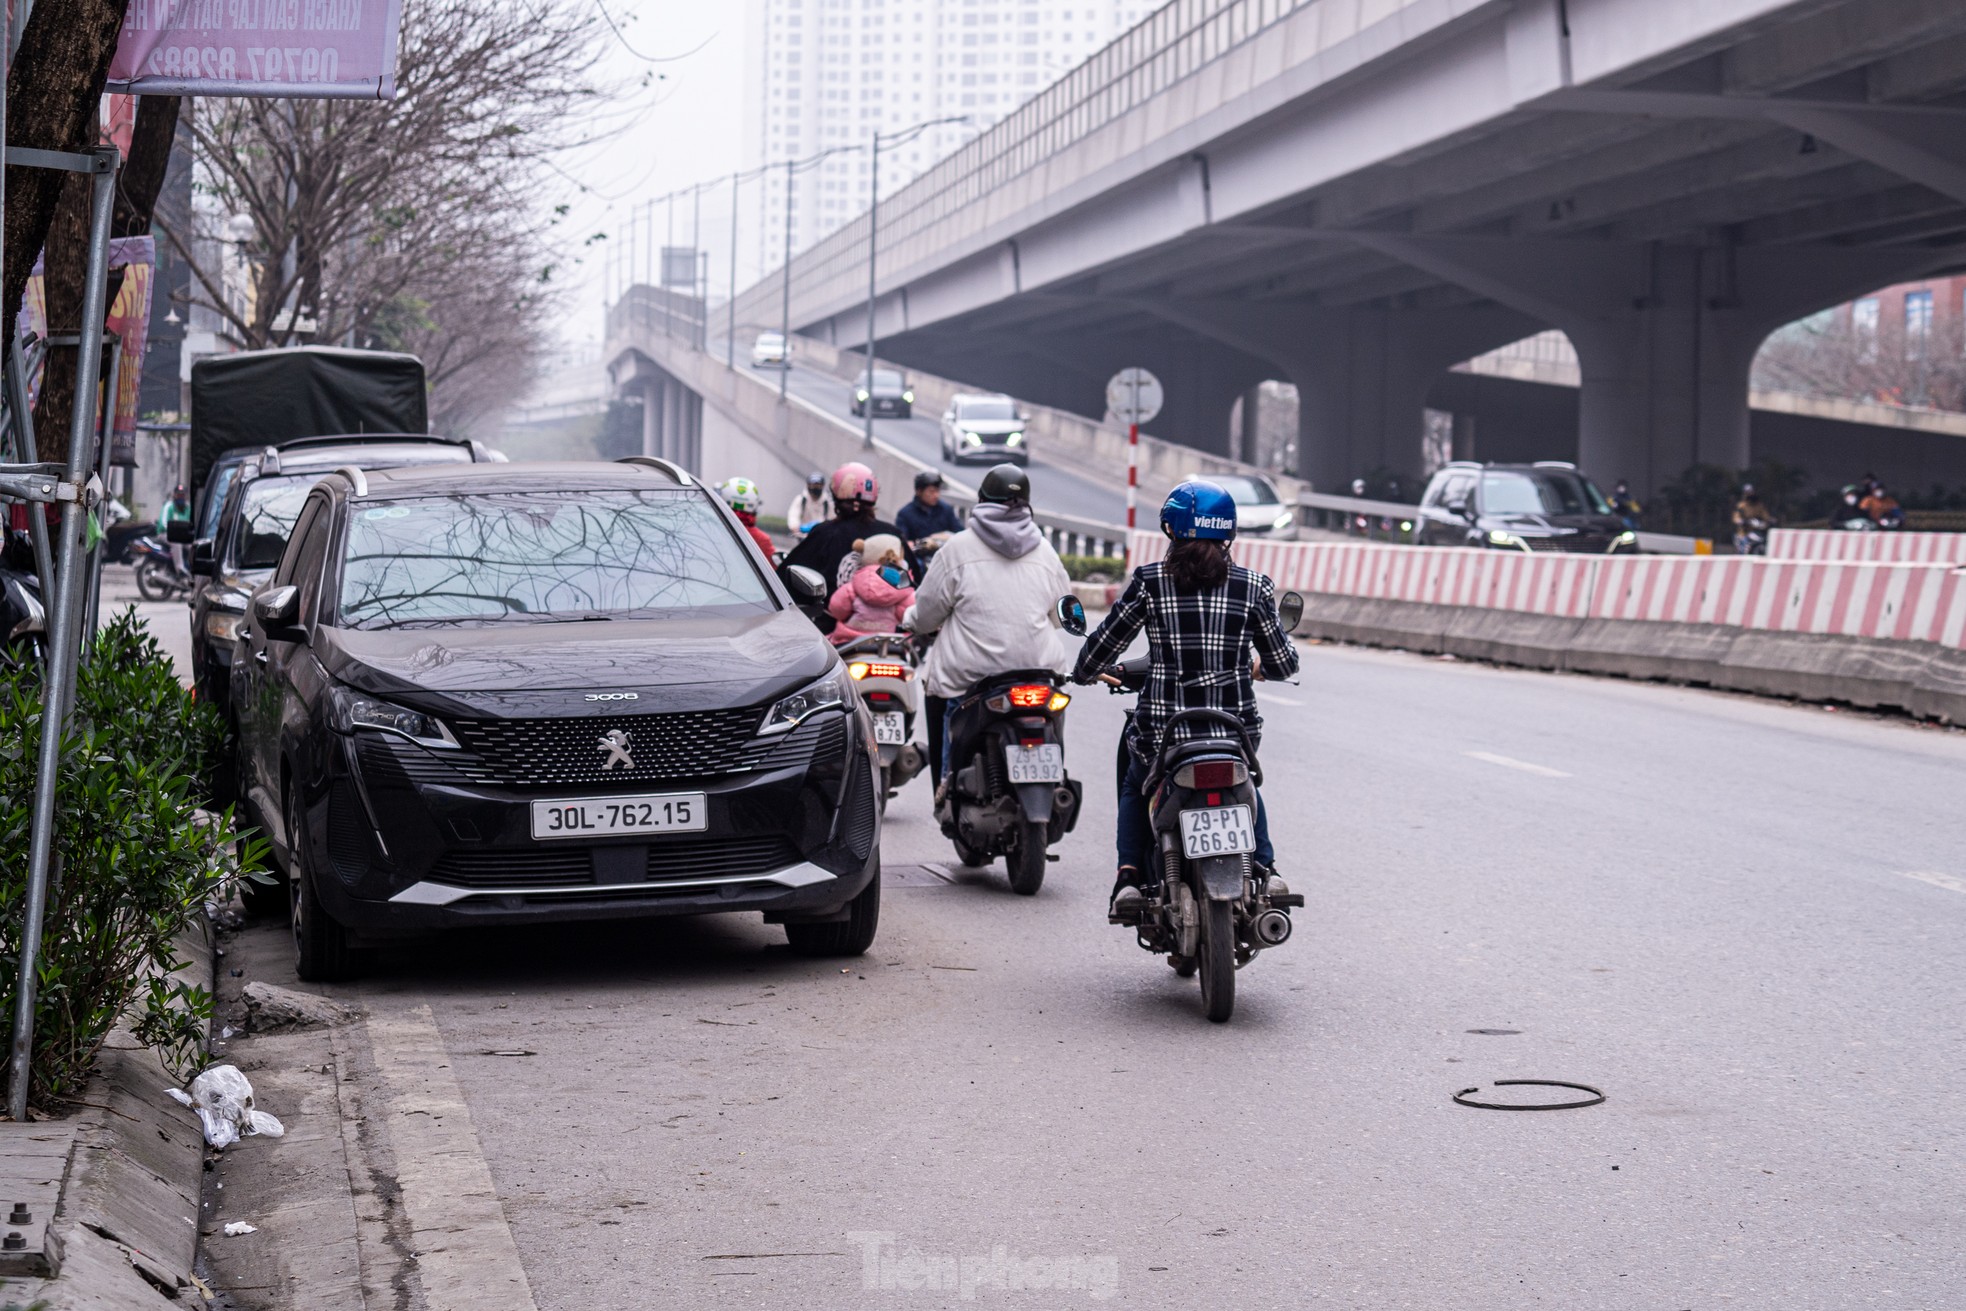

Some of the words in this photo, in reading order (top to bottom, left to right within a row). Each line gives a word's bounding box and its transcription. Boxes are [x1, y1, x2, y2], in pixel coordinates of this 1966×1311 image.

[584, 692, 639, 701] 3008
[1012, 764, 1059, 780] 613.92
[548, 802, 691, 830] 30L-762.15
[1191, 809, 1240, 832] 29-P1
[1188, 829, 1250, 854] 266.91
